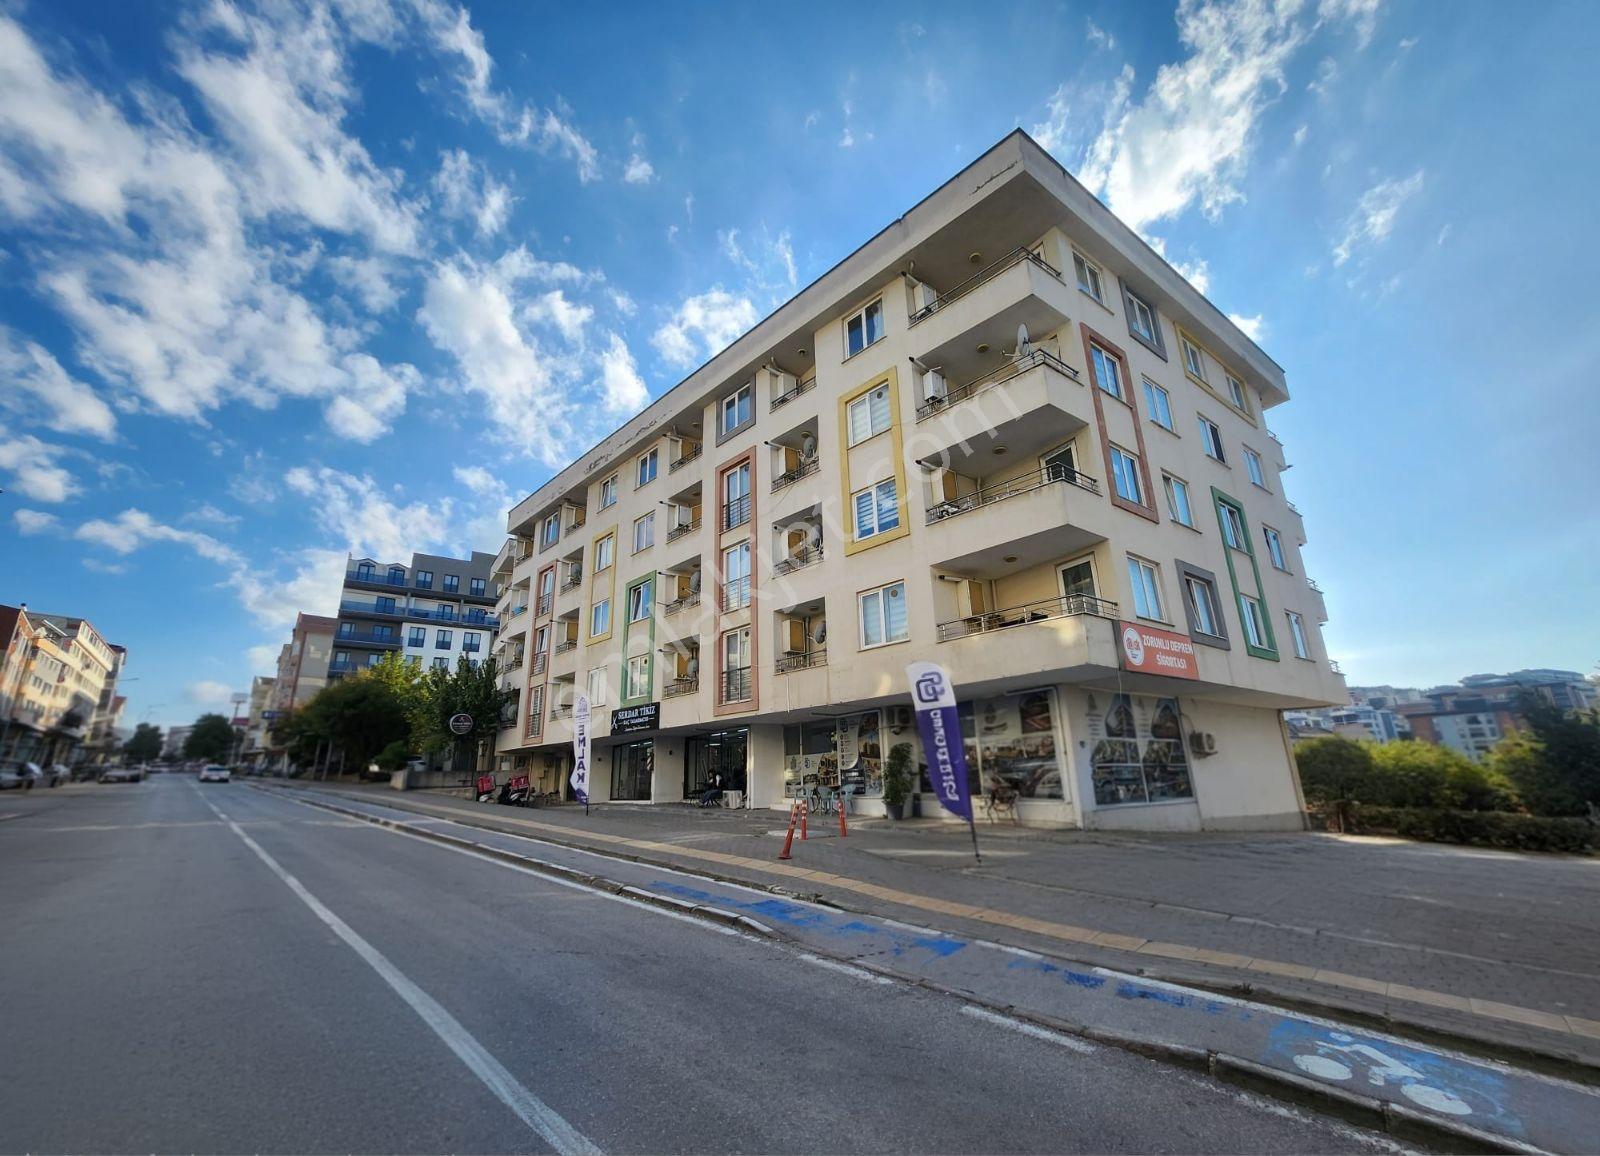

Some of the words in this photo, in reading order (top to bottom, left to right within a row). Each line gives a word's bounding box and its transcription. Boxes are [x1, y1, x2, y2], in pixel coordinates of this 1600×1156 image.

[1142, 634, 1169, 650] ZORUNLU
[1169, 640, 1194, 655] DEPREM
[618, 708, 639, 720] SERDAR
